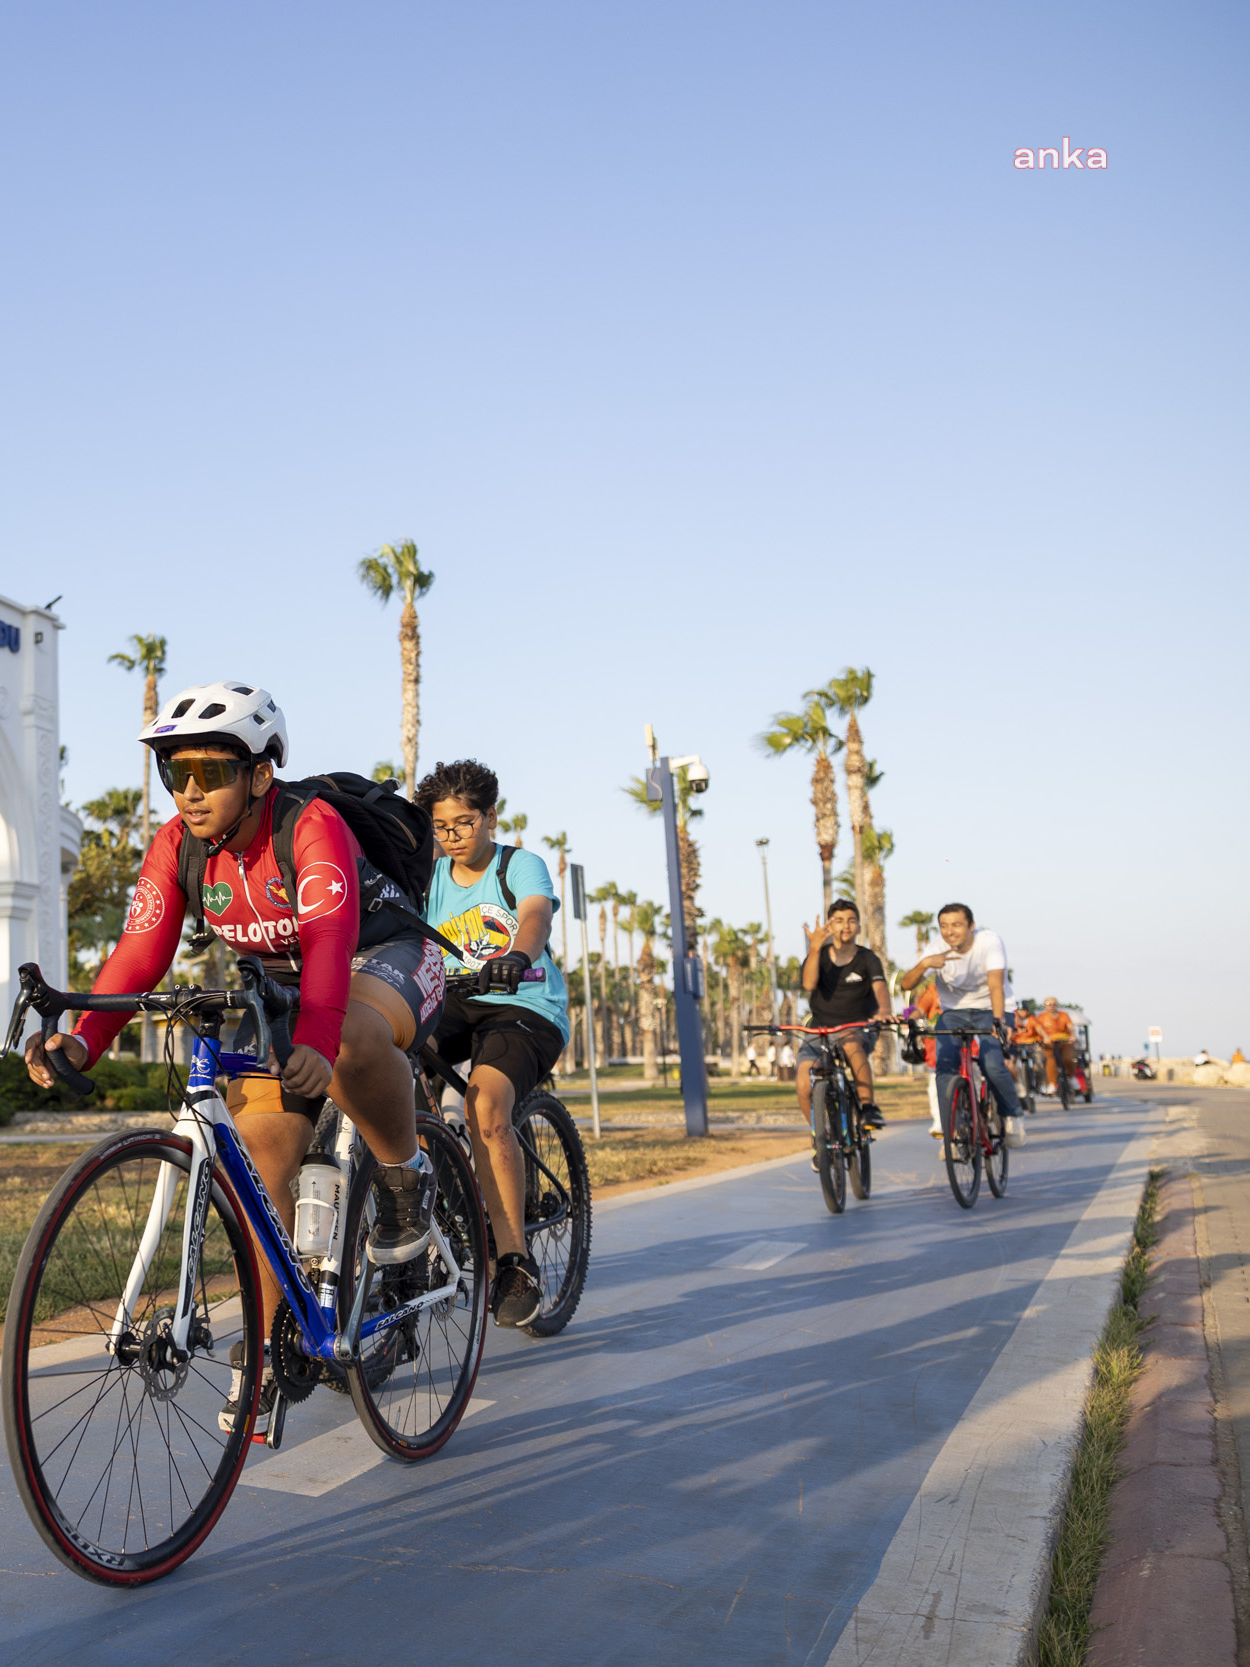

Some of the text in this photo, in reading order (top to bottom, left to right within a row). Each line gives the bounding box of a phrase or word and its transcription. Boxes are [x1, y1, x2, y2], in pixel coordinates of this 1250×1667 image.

[188, 1158, 210, 1284] SALCANO
[229, 1125, 311, 1293] SALCANO
[333, 1184, 341, 1241] MAUTEN
[375, 1301, 424, 1331] SALCANO
